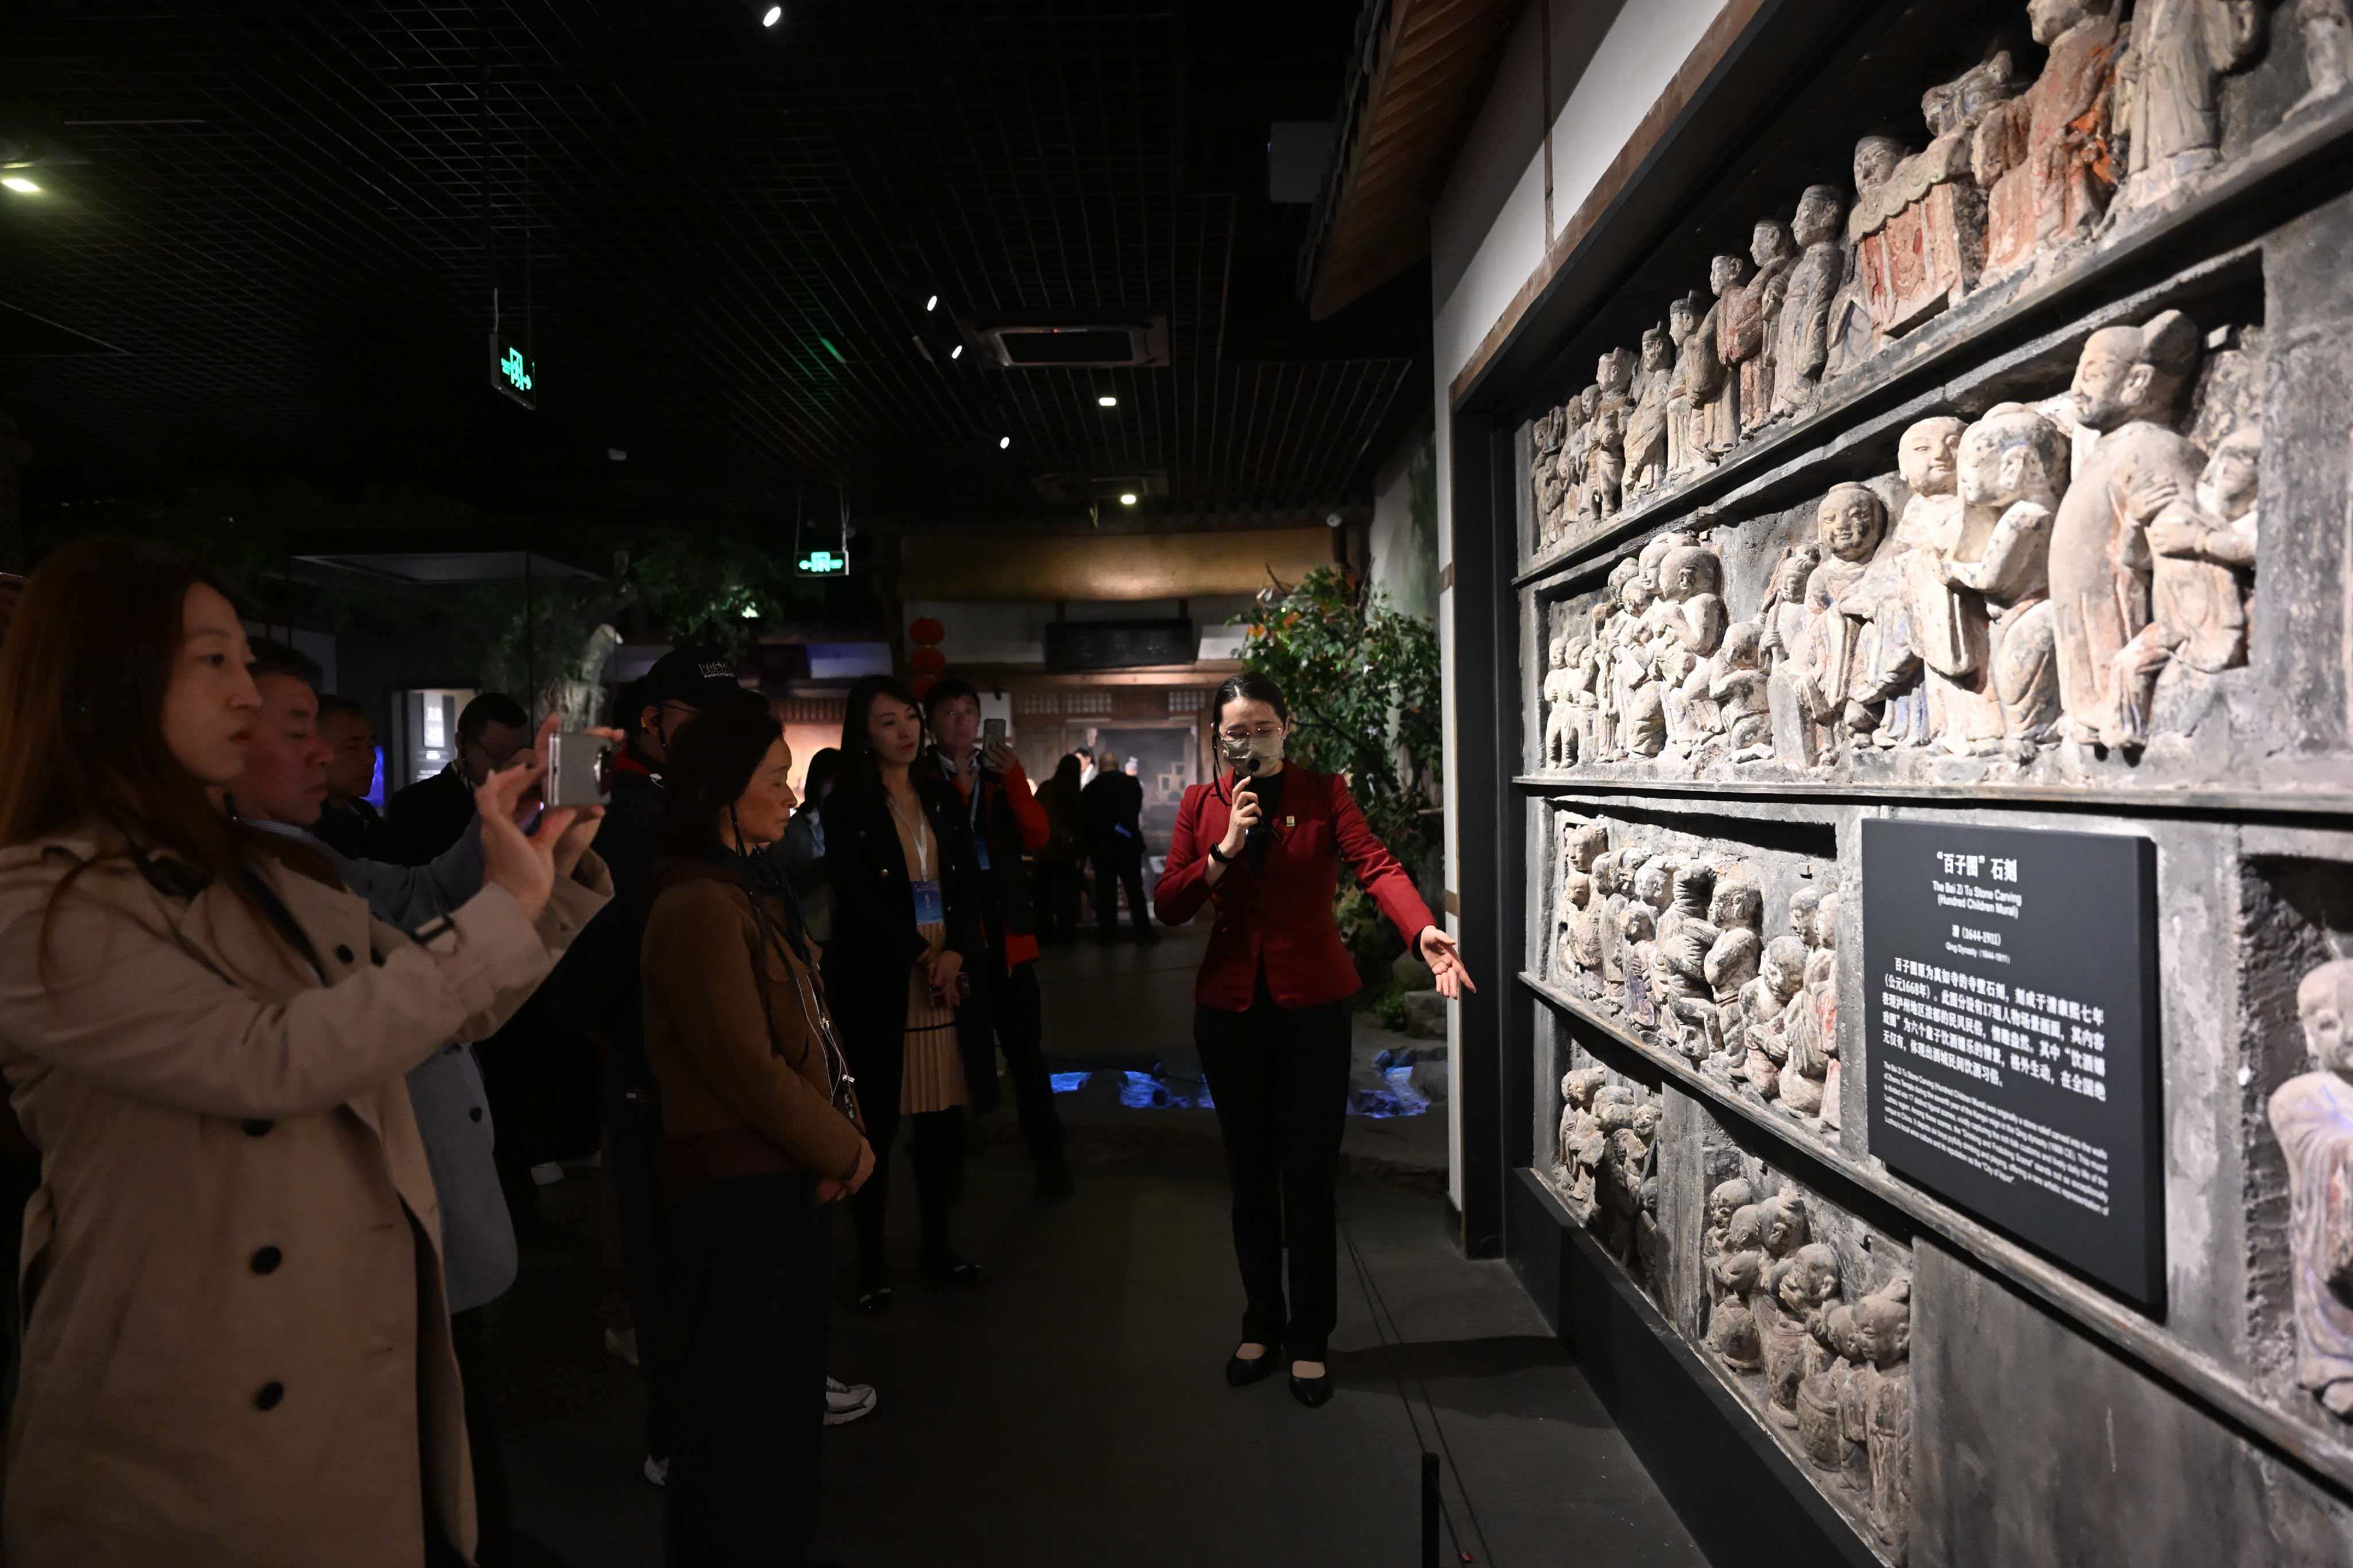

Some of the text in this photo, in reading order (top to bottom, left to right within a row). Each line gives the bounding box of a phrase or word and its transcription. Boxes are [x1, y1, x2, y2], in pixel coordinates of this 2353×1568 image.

[1937, 850, 2018, 883] “百子图” 石刻
[1932, 880, 1945, 893] The
